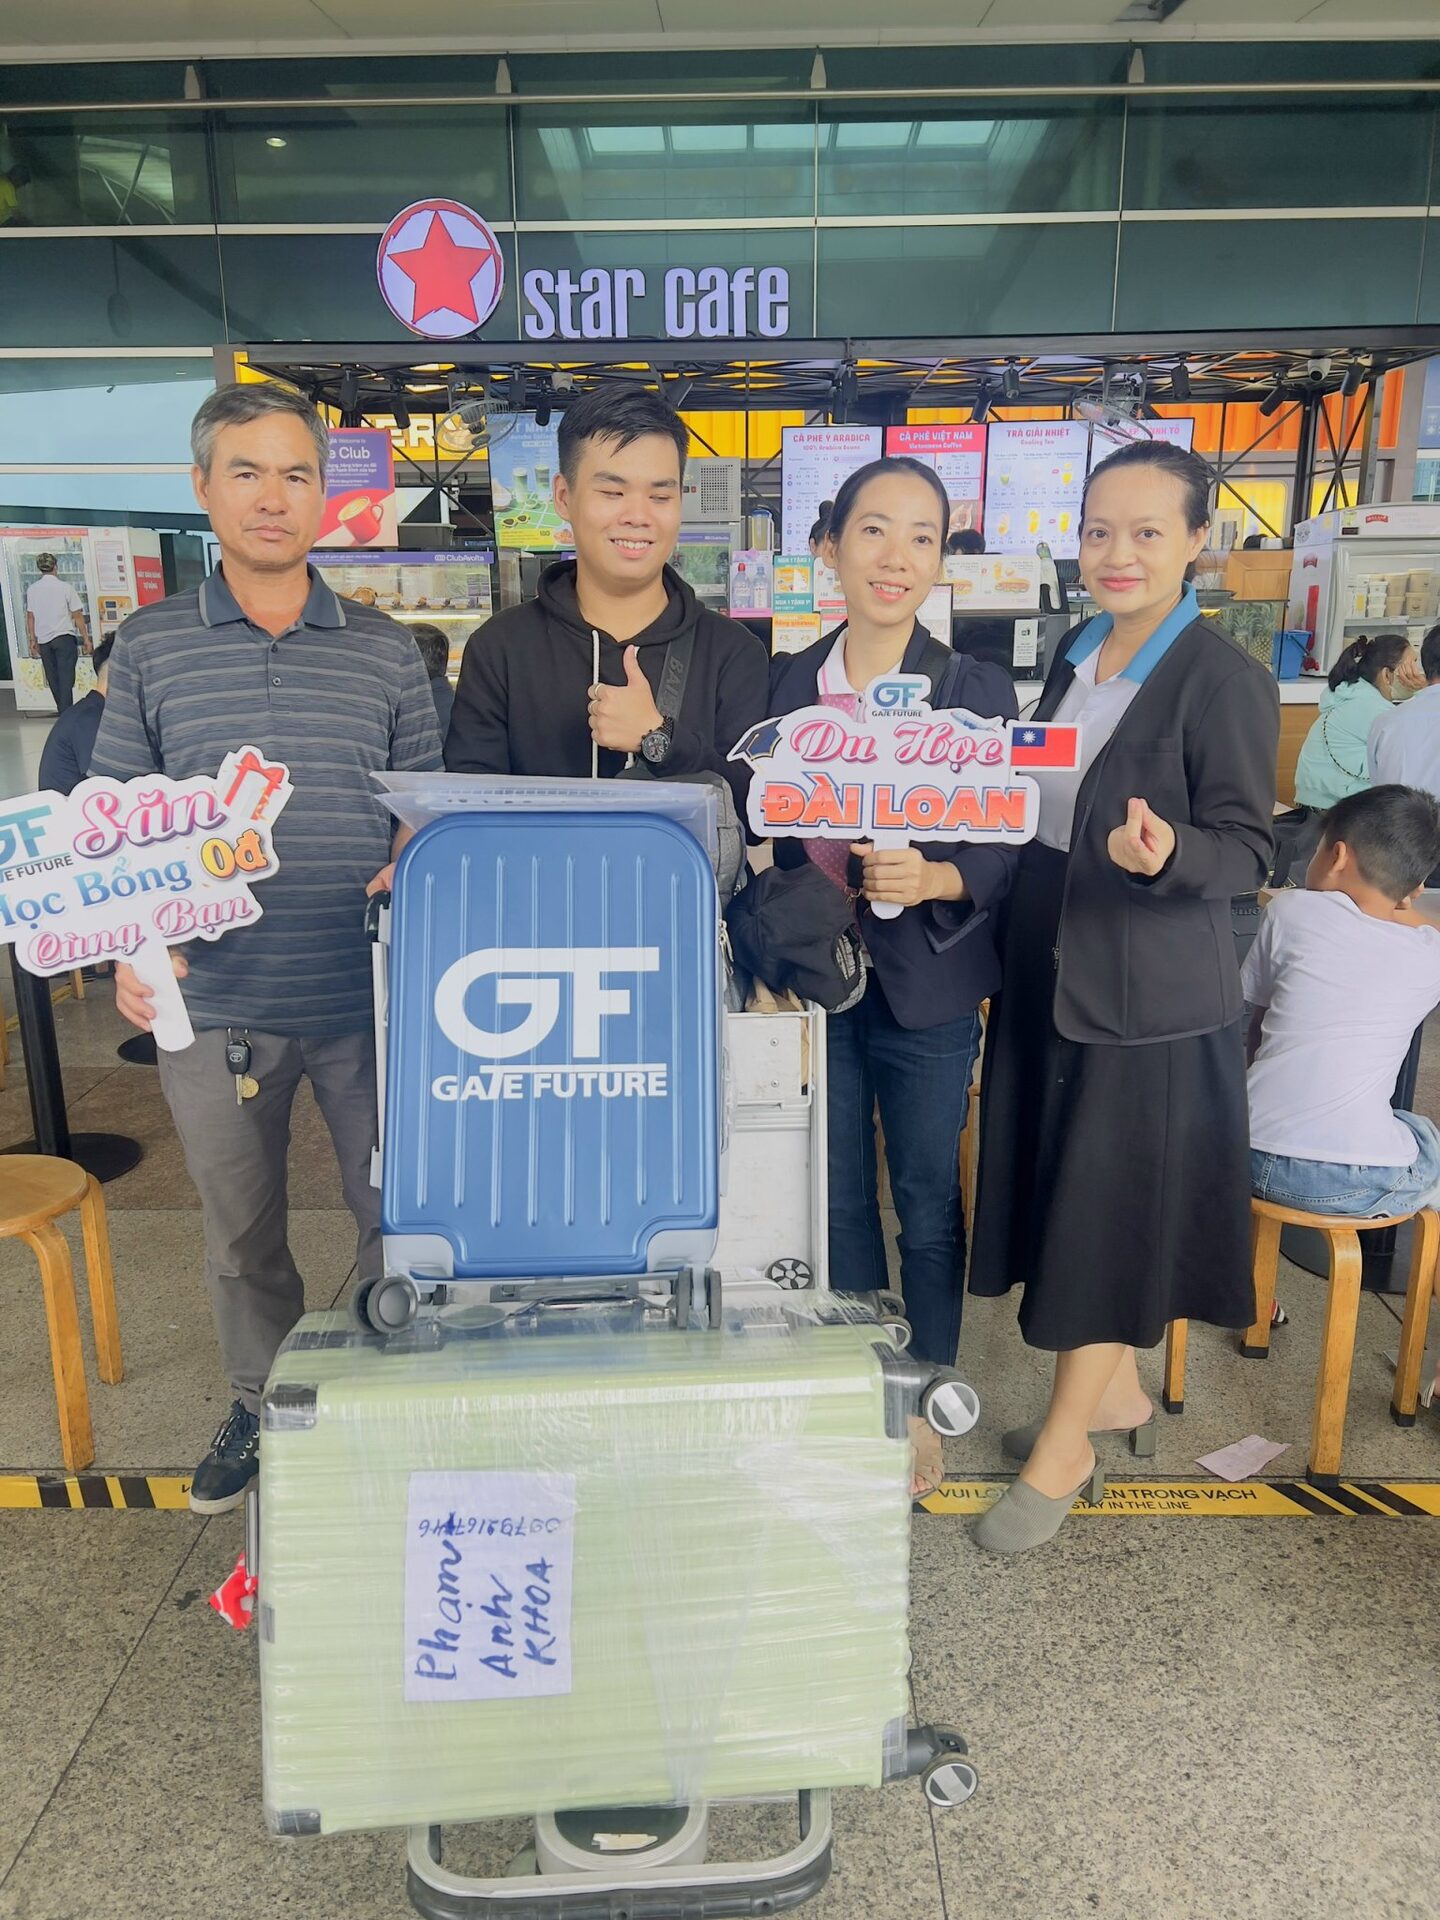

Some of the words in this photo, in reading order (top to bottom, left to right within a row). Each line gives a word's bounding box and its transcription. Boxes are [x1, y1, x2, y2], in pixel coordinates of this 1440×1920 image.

[339, 446, 371, 459] Club
[833, 433, 871, 442] ARABICA
[932, 430, 951, 442] VIỆT
[953, 431, 973, 440] NAM
[873, 682, 923, 708] GF
[790, 719, 878, 765] Du
[894, 720, 1005, 774] Học
[73, 789, 228, 859] Săn
[761, 771, 866, 831] ĐÀI
[872, 783, 1027, 832] LOAN
[16, 855, 74, 878] FUTURE
[74, 856, 192, 907] Bổng
[200, 829, 269, 879] 0đ
[28, 921, 146, 969] Cùng
[152, 896, 254, 938] Bạn
[434, 947, 660, 1059] GF
[431, 1064, 523, 1101] GATE
[533, 1070, 668, 1099] FUTURE
[938, 1488, 969, 1499] VUI
[1128, 1488, 1200, 1499] TRONG
[1201, 1489, 1257, 1502] VẠCH
[1109, 1501, 1127, 1510] IN
[1128, 1501, 1156, 1510] THE
[1158, 1501, 1192, 1510] LINE
[413, 1538, 474, 1681] Phạm
[478, 1573, 519, 1679] Anh
[520, 1556, 558, 1666] KHOA
